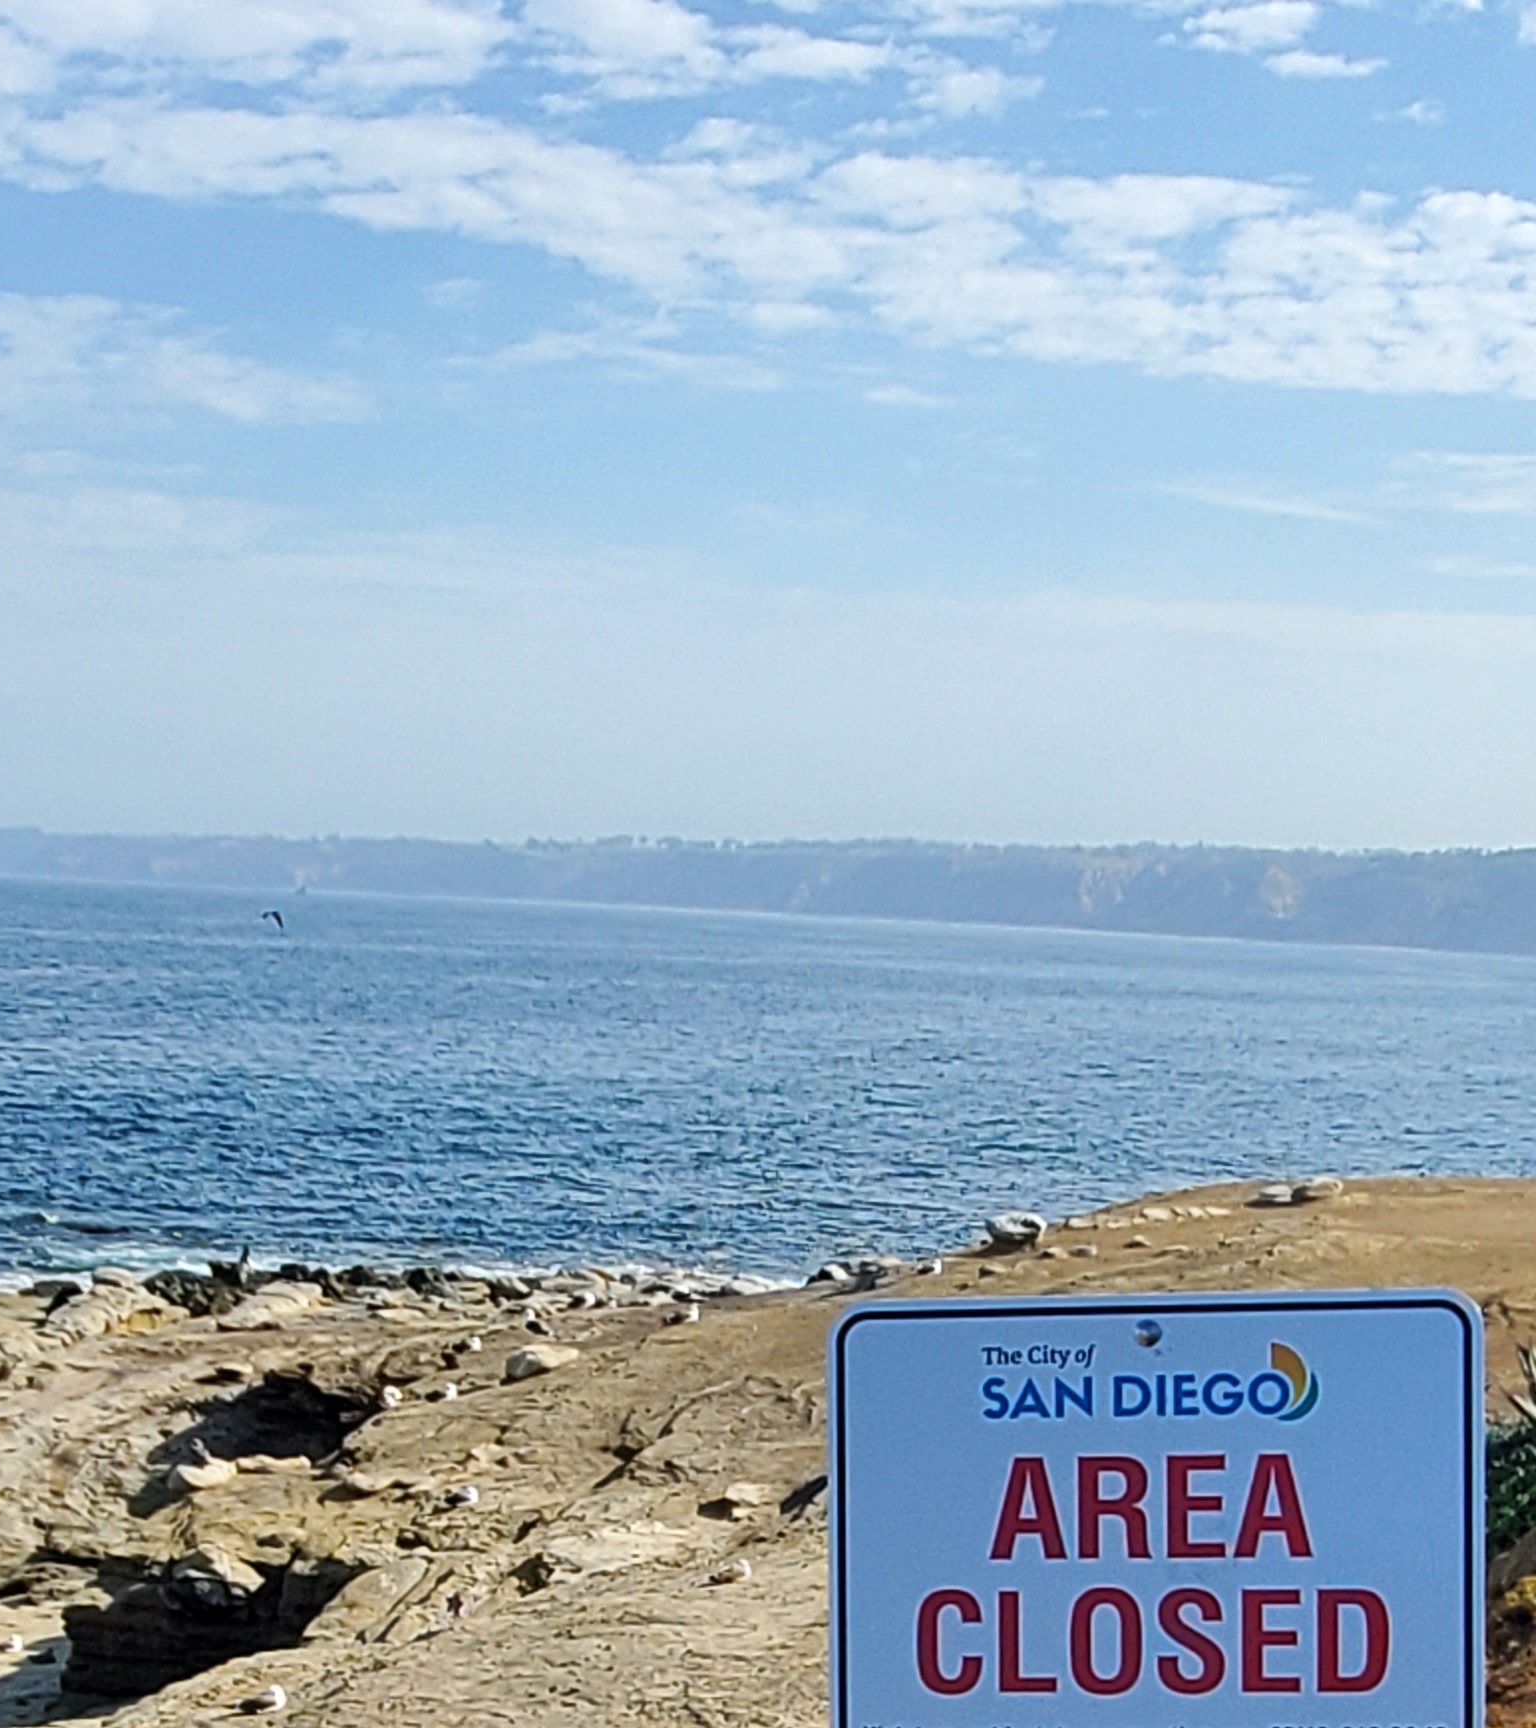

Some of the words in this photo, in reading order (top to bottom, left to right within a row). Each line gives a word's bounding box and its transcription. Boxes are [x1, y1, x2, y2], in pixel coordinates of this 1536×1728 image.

[981, 1346, 1022, 1366] The
[1027, 1344, 1070, 1368] City
[1075, 1344, 1096, 1367] of
[982, 1376, 1093, 1419] SAN
[1113, 1372, 1290, 1417] DIEGO
[990, 1453, 1314, 1560] AREA
[916, 1587, 1391, 1694] CLOSED
